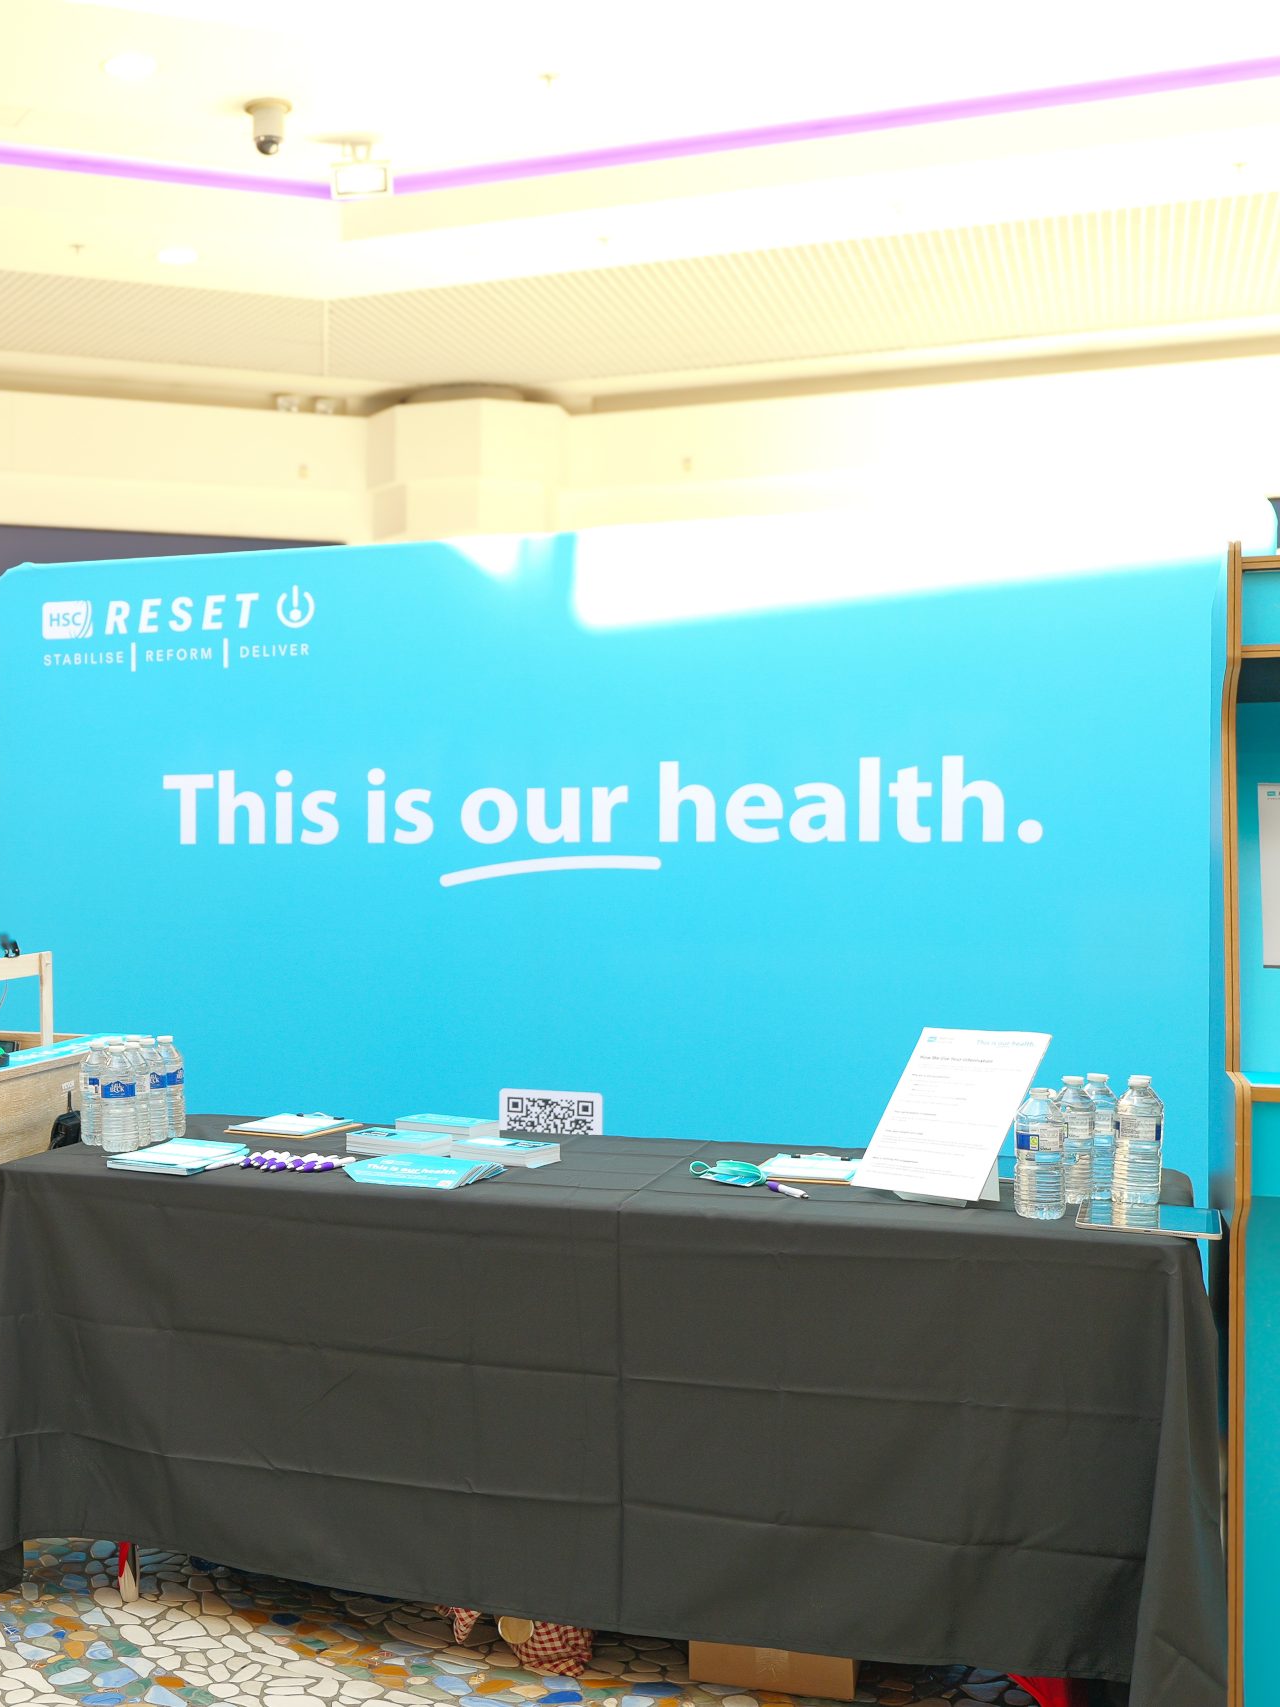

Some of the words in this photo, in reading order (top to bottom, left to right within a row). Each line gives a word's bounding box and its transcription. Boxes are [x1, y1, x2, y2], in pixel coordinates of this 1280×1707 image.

[49, 612, 83, 627] HSC
[104, 592, 260, 636] RESET
[43, 651, 125, 667] STABILISE
[145, 648, 213, 663] REFORM
[239, 643, 310, 659] DELIVER
[163, 770, 339, 845] This
[367, 768, 433, 845] is
[460, 787, 629, 845] our
[659, 755, 1044, 844] health.
[367, 1163, 389, 1171] This
